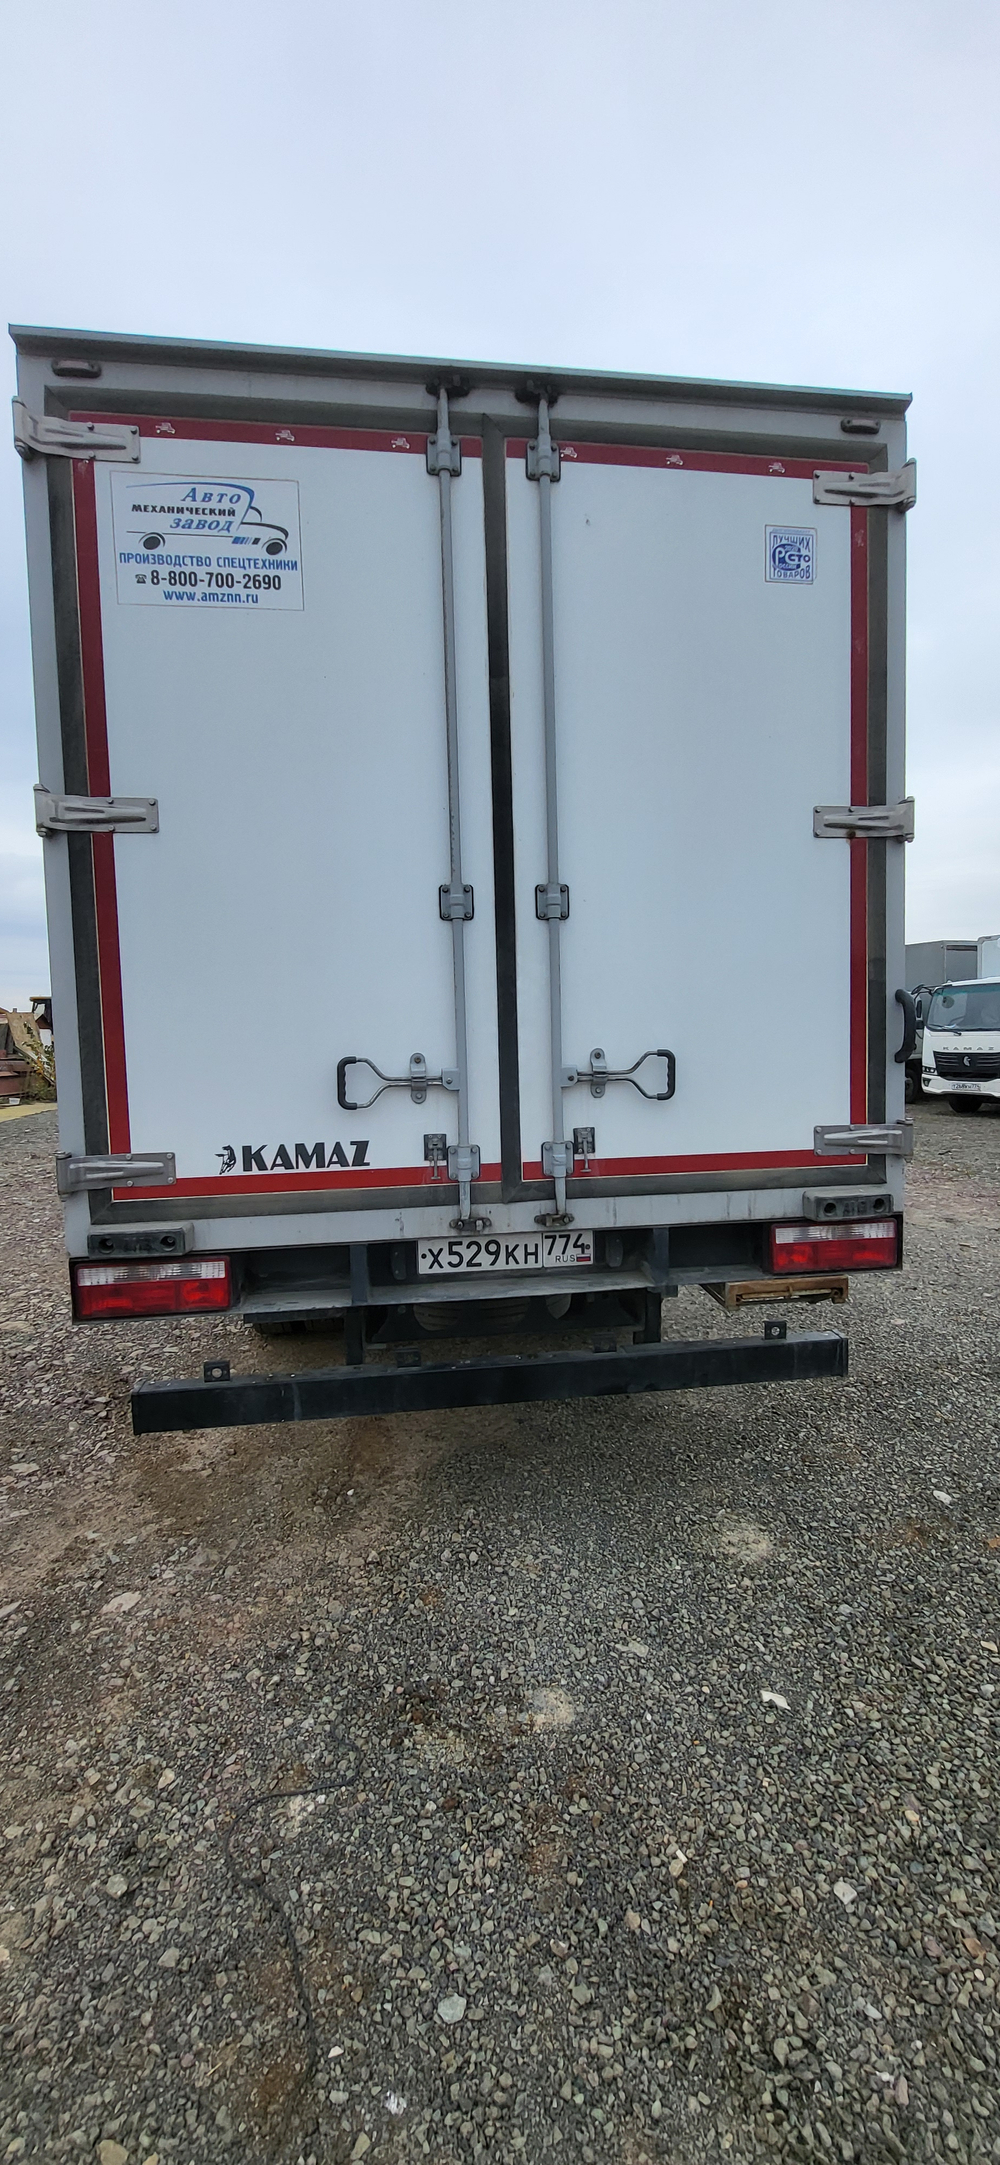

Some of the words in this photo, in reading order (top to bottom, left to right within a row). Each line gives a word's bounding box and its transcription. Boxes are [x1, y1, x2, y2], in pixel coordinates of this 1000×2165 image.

[131, 504, 236, 517] МЕХАНИЧЕСКИЙ
[772, 534, 811, 553] ЛУЧШИХ
[119, 552, 212, 568] ПРОИЗВОДСТВО
[216, 556, 298, 571] СПЕЦТЕХНИКИ
[150, 570, 282, 590] 8-800-700-2690
[772, 565, 811, 579] ТОВАРОВ
[163, 590, 259, 604] www.amznn.ru
[241, 1140, 371, 1172] KAMAZ
[427, 1239, 539, 1269] Х529КН
[544, 1233, 586, 1255] 774
[555, 1254, 576, 1263] RUS
